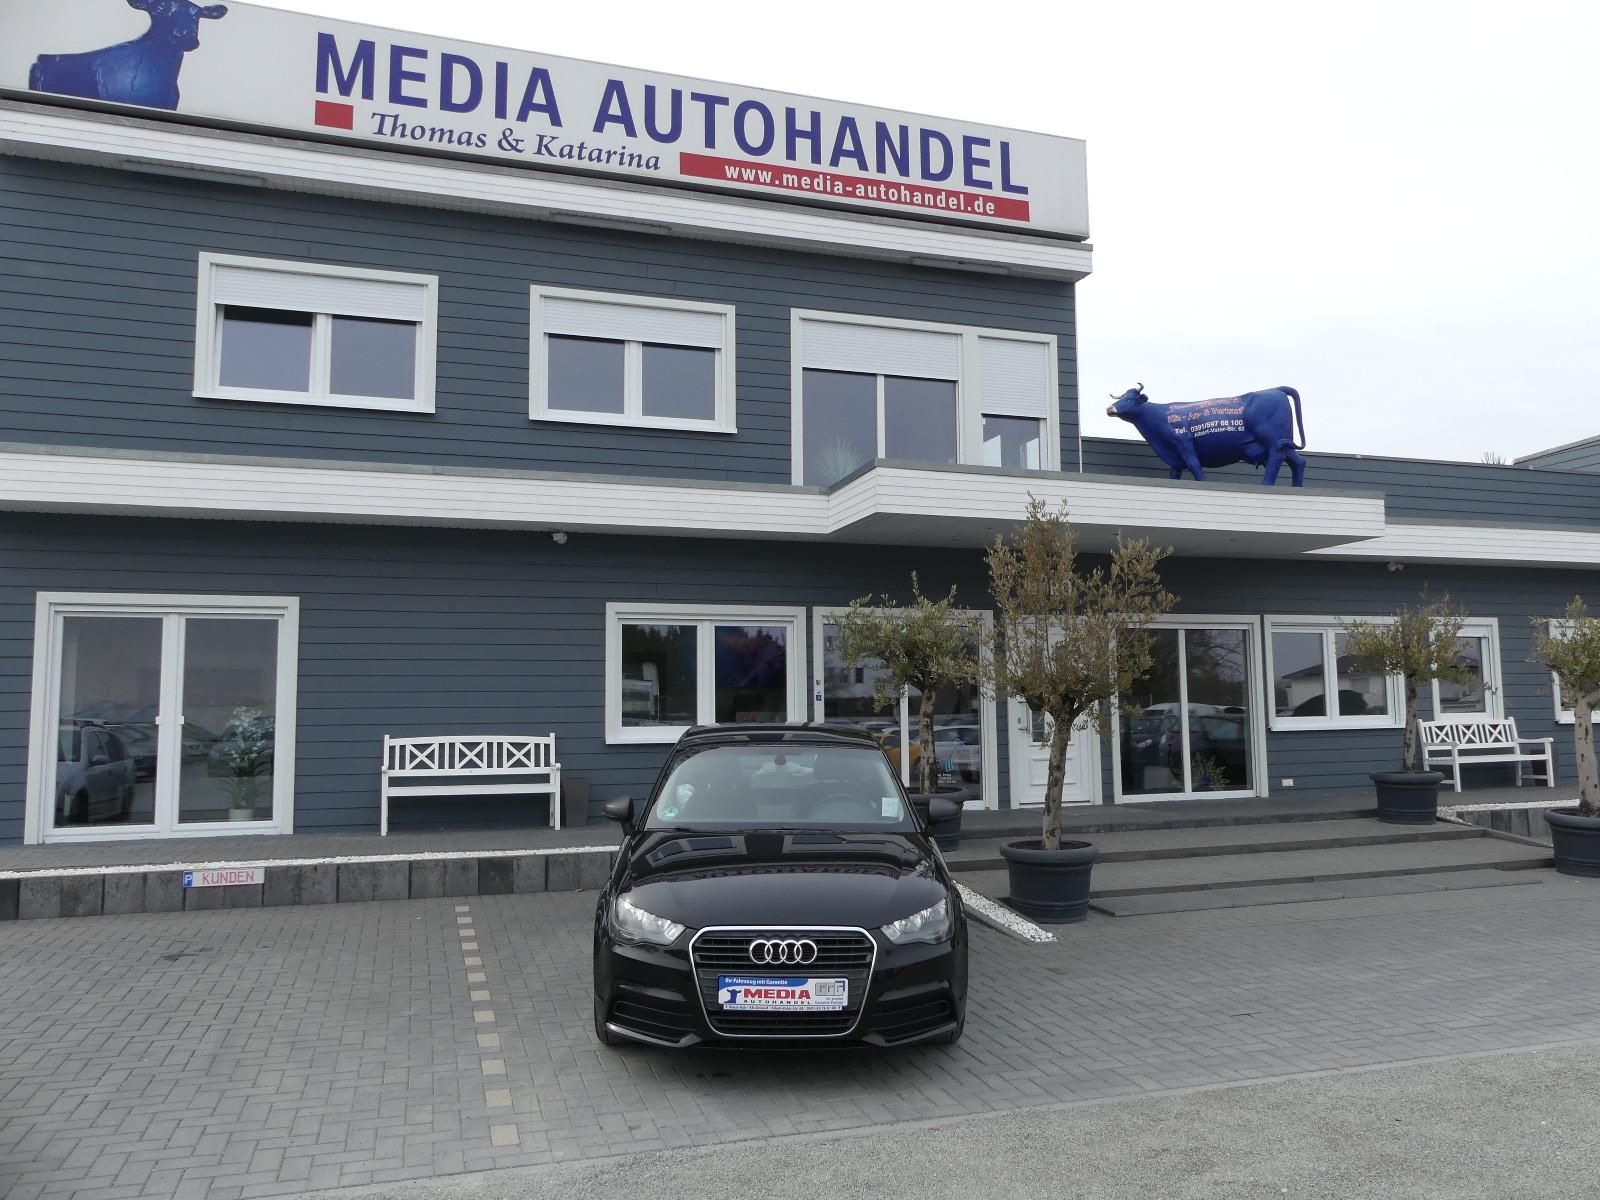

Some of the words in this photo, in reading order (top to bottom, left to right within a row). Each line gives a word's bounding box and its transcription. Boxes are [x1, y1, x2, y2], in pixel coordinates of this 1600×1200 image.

[315, 32, 561, 128] MEDIA
[594, 79, 1029, 195] AUTOHANDEL
[371, 111, 487, 150] Thomas
[496, 127, 525, 154] &
[532, 134, 662, 173] Katarina
[724, 163, 996, 216] www.media-autohandel.de
[1190, 420, 1219, 433] 0391/597
[185, 874, 193, 884] P
[202, 871, 254, 885] KUNDEN
[743, 988, 811, 1000] MEDIA
